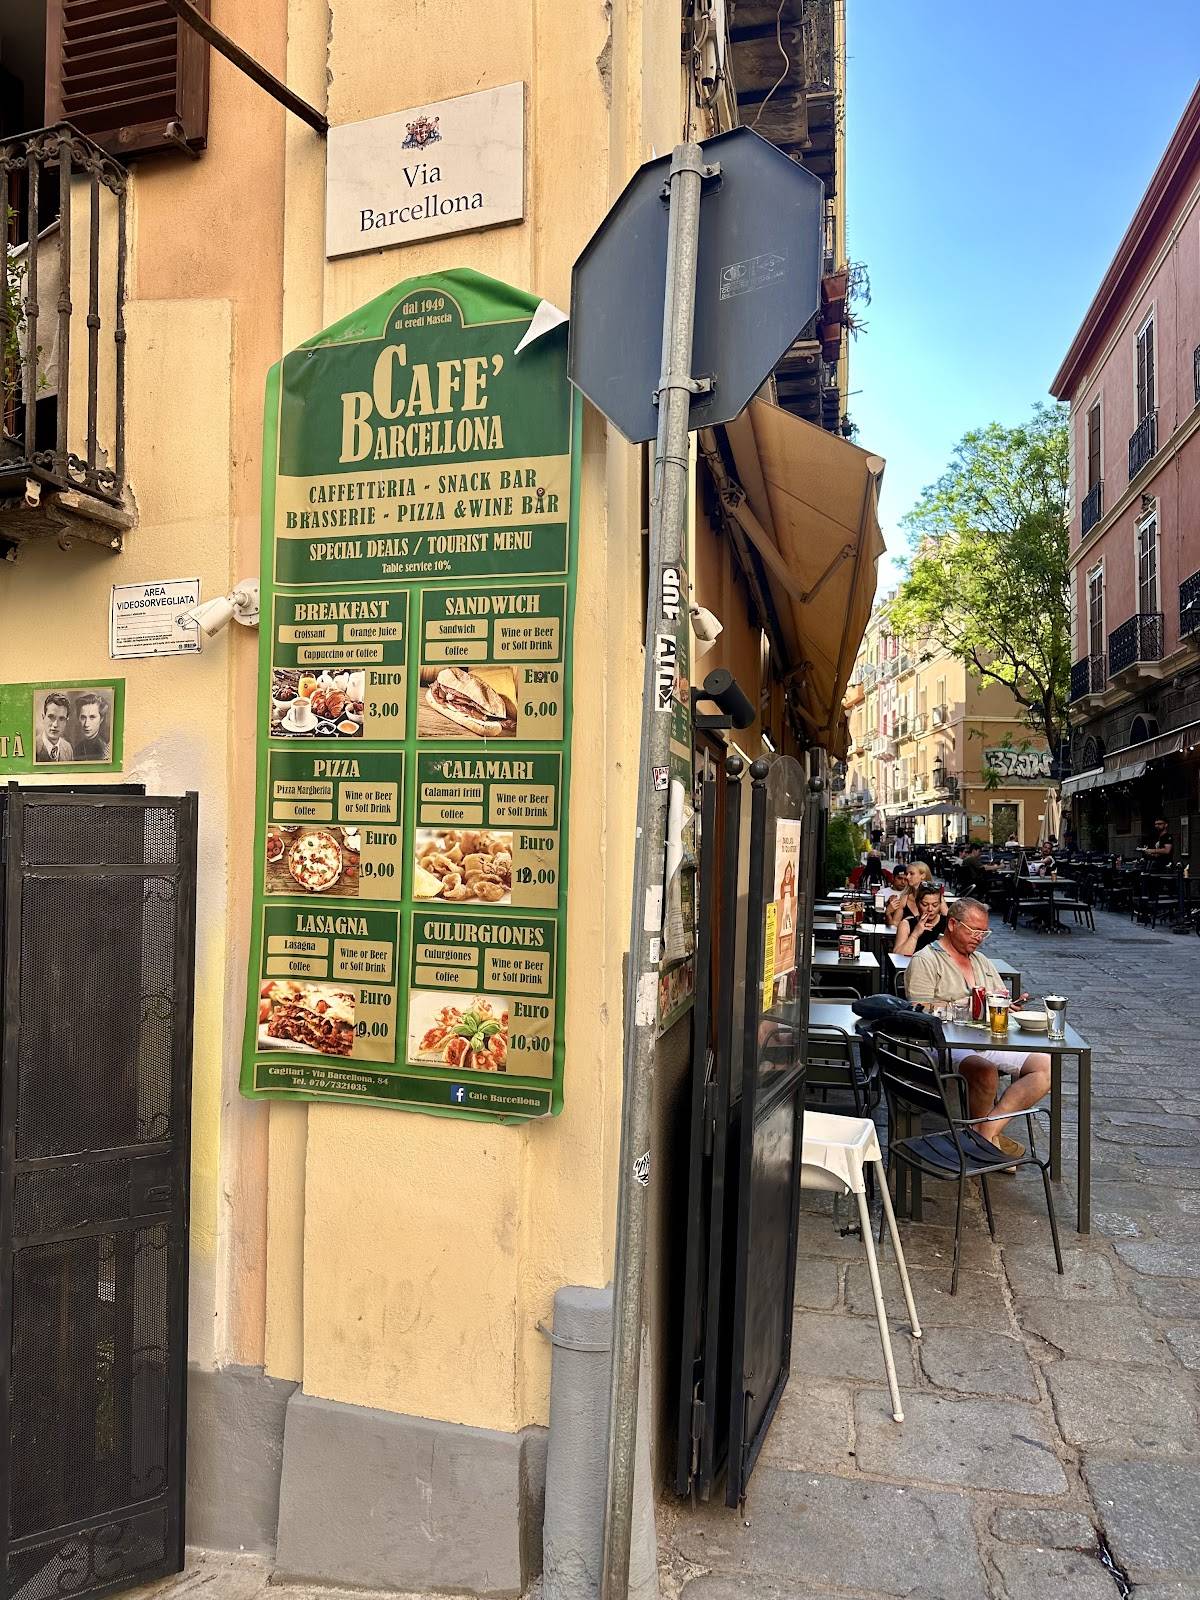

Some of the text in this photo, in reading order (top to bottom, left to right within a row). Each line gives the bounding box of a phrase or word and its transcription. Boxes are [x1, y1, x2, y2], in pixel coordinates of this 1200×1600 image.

[402, 163, 442, 188] Via
[360, 192, 484, 232] Barcellona
[403, 298, 444, 314] dal 1949
[395, 313, 452, 329] di eredi Mascia
[339, 391, 504, 463] BARCELLONA
[309, 479, 416, 504] CAFFETTERIA
[439, 471, 491, 493] SNACK
[500, 469, 537, 490] BAR
[286, 507, 375, 529] BRASSERIE
[398, 502, 445, 522] PIZZA
[522, 495, 559, 515] BAR
[309, 531, 532, 561] SPECIAL DEALS / TOURIST MENU
[382, 560, 451, 573] Table service 10%
[144, 587, 165, 597] AREA
[117, 596, 194, 610] VIDEOSORVEGLIATA
[446, 595, 540, 616] SANDWICH
[295, 600, 389, 621] BREAKFAST
[294, 629, 326, 638] Croissant
[350, 627, 396, 637] Orange Juice
[440, 624, 476, 634] Sandwich
[501, 627, 553, 637] Wine or Beer
[445, 646, 468, 656] Coffee
[512, 641, 528, 650] Soft
[530, 640, 552, 650] Drink
[304, 649, 344, 660] Cappuccino
[356, 649, 378, 657] Coffee
[370, 672, 401, 685] Euro
[525, 669, 558, 683] Euro
[370, 703, 399, 718] 3,00
[525, 702, 557, 717] 6,00
[314, 760, 360, 777] PIZZA
[442, 760, 534, 780] CALAMARI
[277, 785, 331, 795] Pizza Margherita
[345, 790, 362, 800] Wine
[375, 791, 392, 800] Beer
[425, 788, 481, 797] Calamari fritti
[496, 793, 548, 804] Wine or Beer
[294, 806, 316, 815] Coffee
[346, 803, 391, 813] or Soft Drink
[441, 810, 464, 819] Coffee
[508, 807, 522, 816] Soft
[525, 807, 548, 817] Drink
[366, 831, 397, 845] Euro
[520, 836, 554, 850] Euro
[296, 914, 368, 936] LASAGNA
[424, 922, 544, 946] CULURGIONES
[284, 940, 316, 951] Lasagna
[340, 948, 358, 958] Wine
[370, 950, 388, 960] Beer
[424, 948, 472, 961] Culurgiones
[289, 961, 310, 971] Coffee
[350, 962, 363, 971] Soft
[366, 963, 386, 972] Drink
[492, 958, 511, 968] Wine
[525, 960, 543, 970] Beer
[436, 972, 459, 982] Coffee
[502, 972, 518, 982] Soft
[520, 974, 542, 984] Drink
[360, 990, 391, 1005] Euro
[514, 1002, 549, 1018] Euro
[511, 1035, 550, 1052] 10,00
[269, 1068, 304, 1076] Cagliari
[490, 1094, 540, 1106] Barcellona
